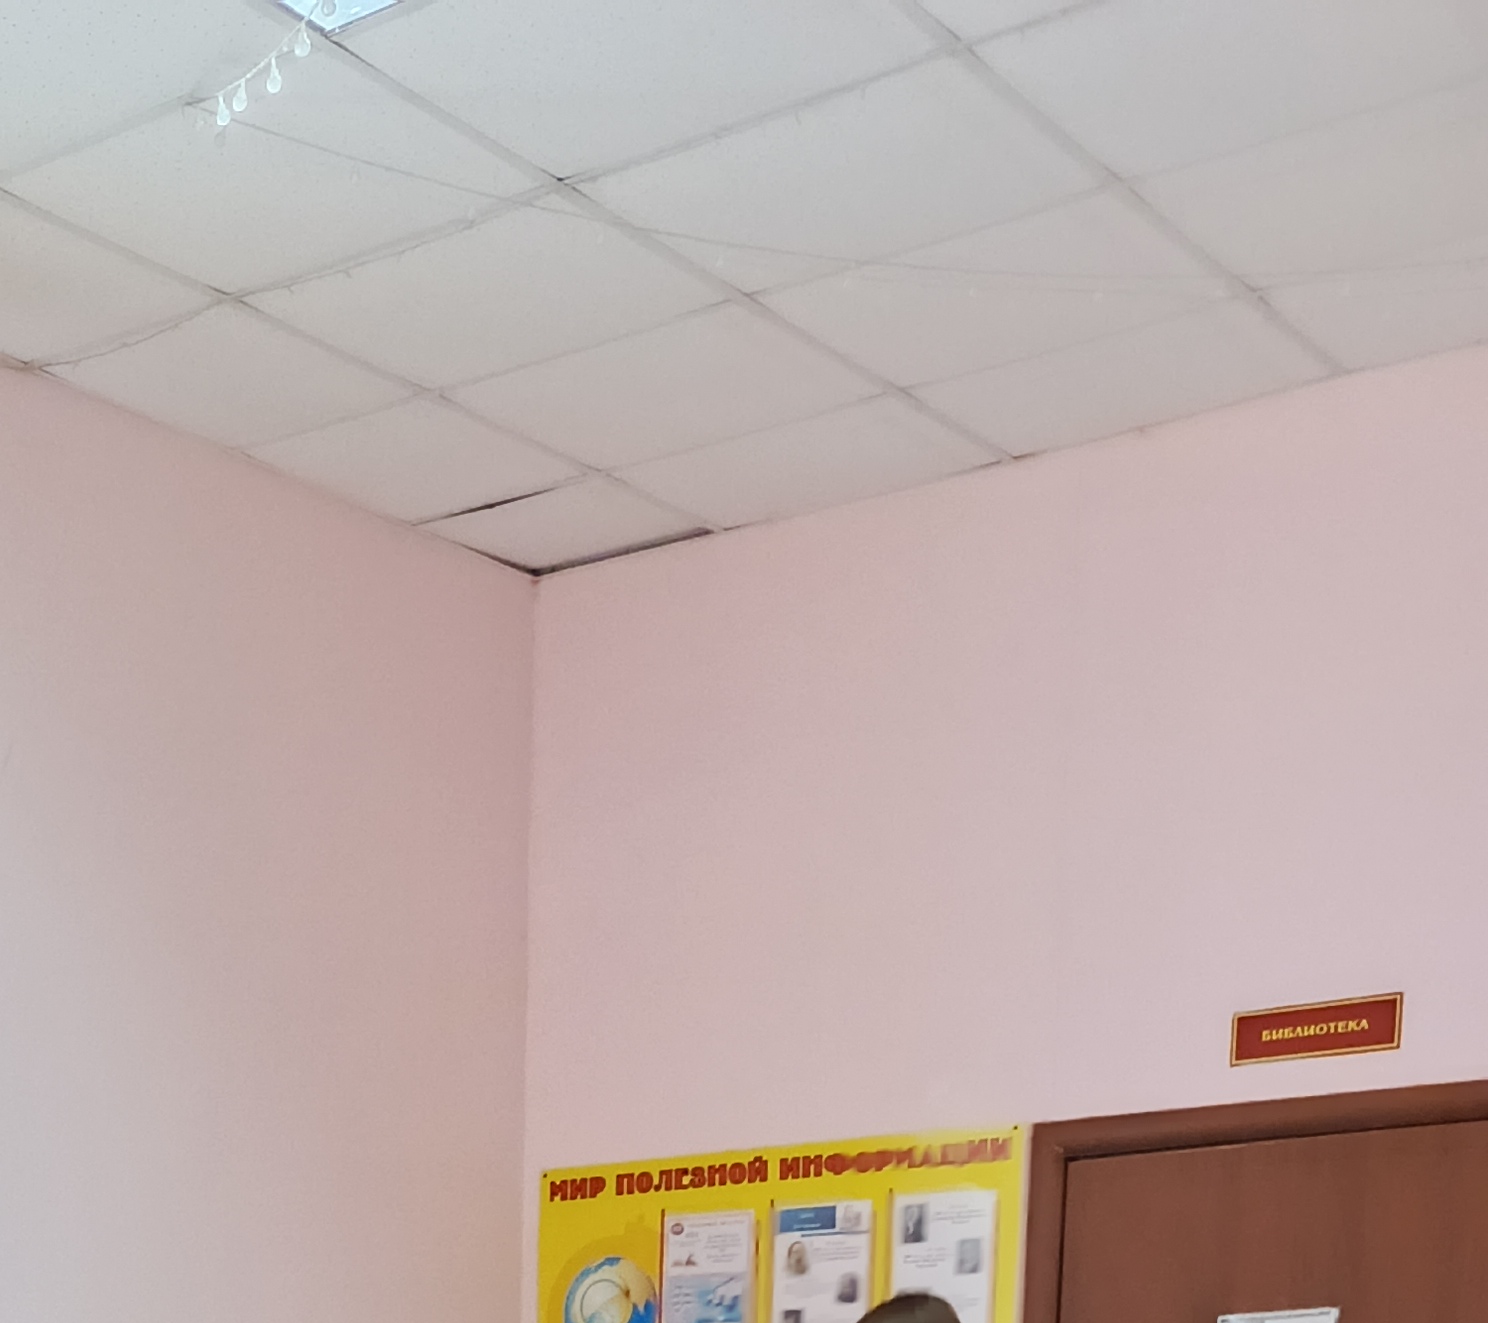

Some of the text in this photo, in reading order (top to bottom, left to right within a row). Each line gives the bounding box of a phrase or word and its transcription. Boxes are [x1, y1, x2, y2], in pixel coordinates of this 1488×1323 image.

[1261, 1018, 1369, 1042] БИБЛИОТЕКА
[549, 1137, 1013, 1203] МИР ПОЛЕЗНОЙ ИНФОРМАЦИИ
